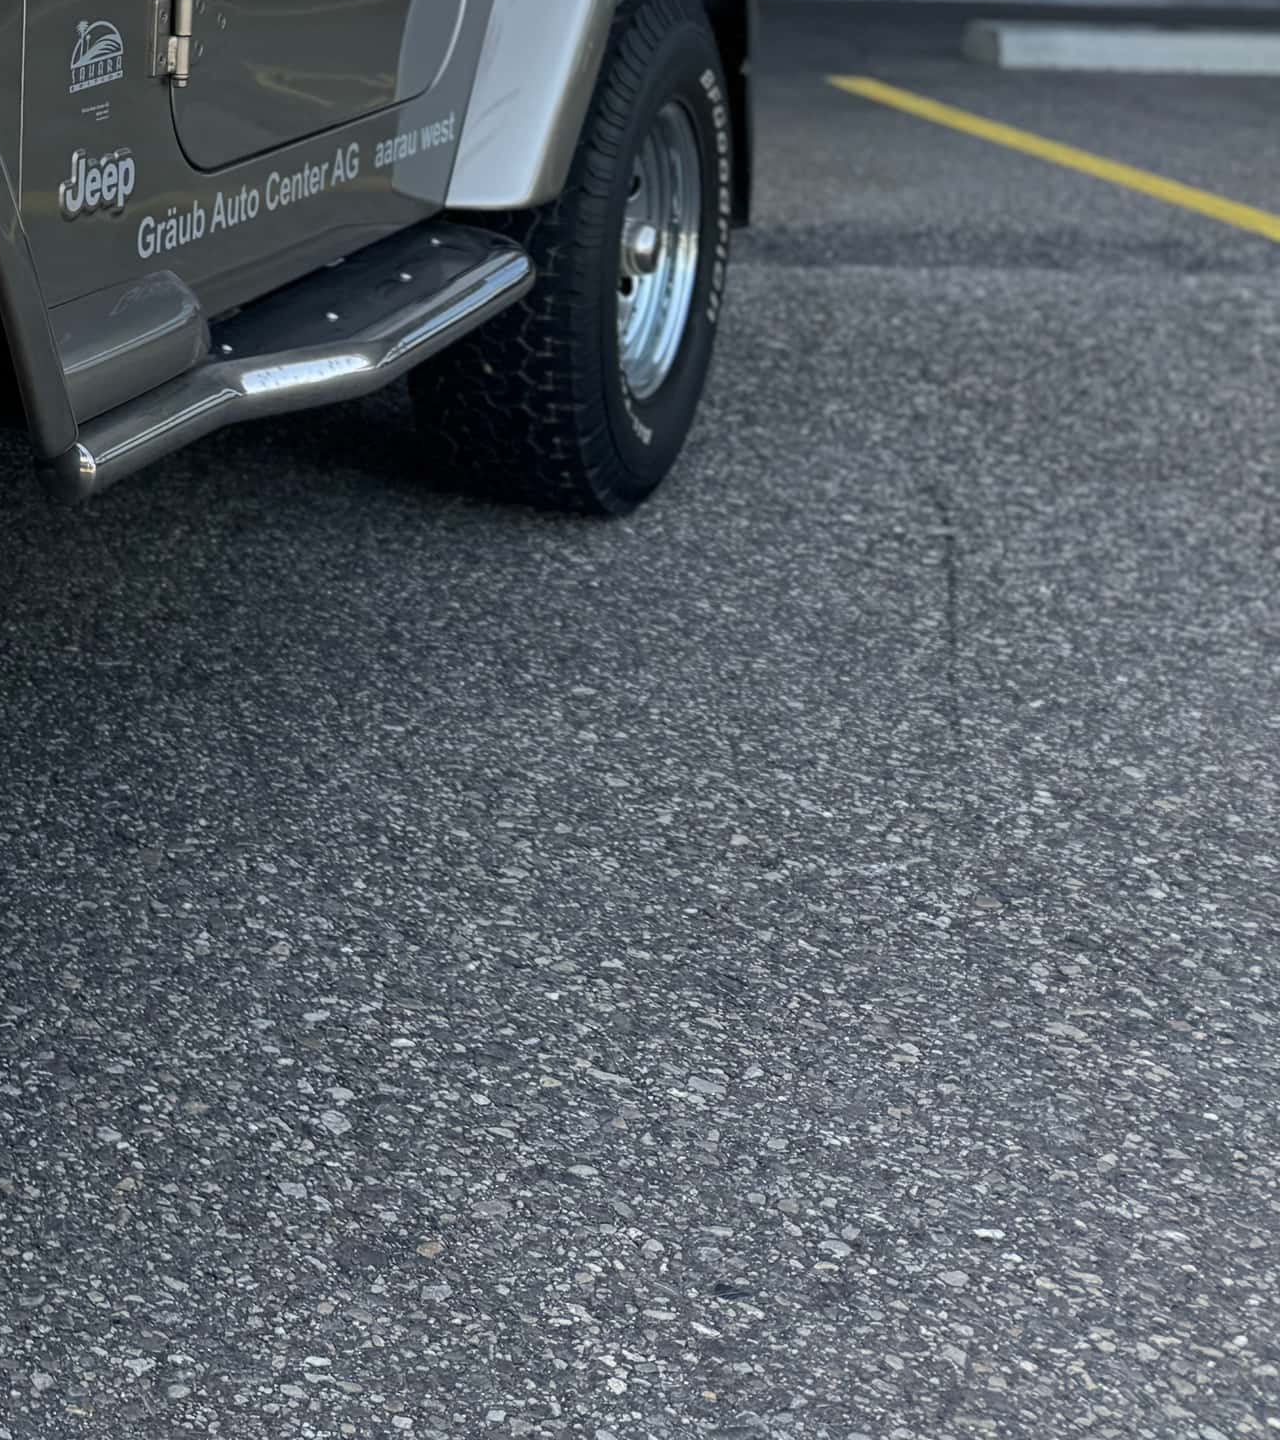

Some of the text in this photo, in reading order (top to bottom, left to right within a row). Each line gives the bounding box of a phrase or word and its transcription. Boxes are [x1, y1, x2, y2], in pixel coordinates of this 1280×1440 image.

[71, 55, 122, 84] SAHARA
[60, 149, 136, 213] Jeep
[138, 112, 456, 259] Gräub Auto Center AG aarau west
